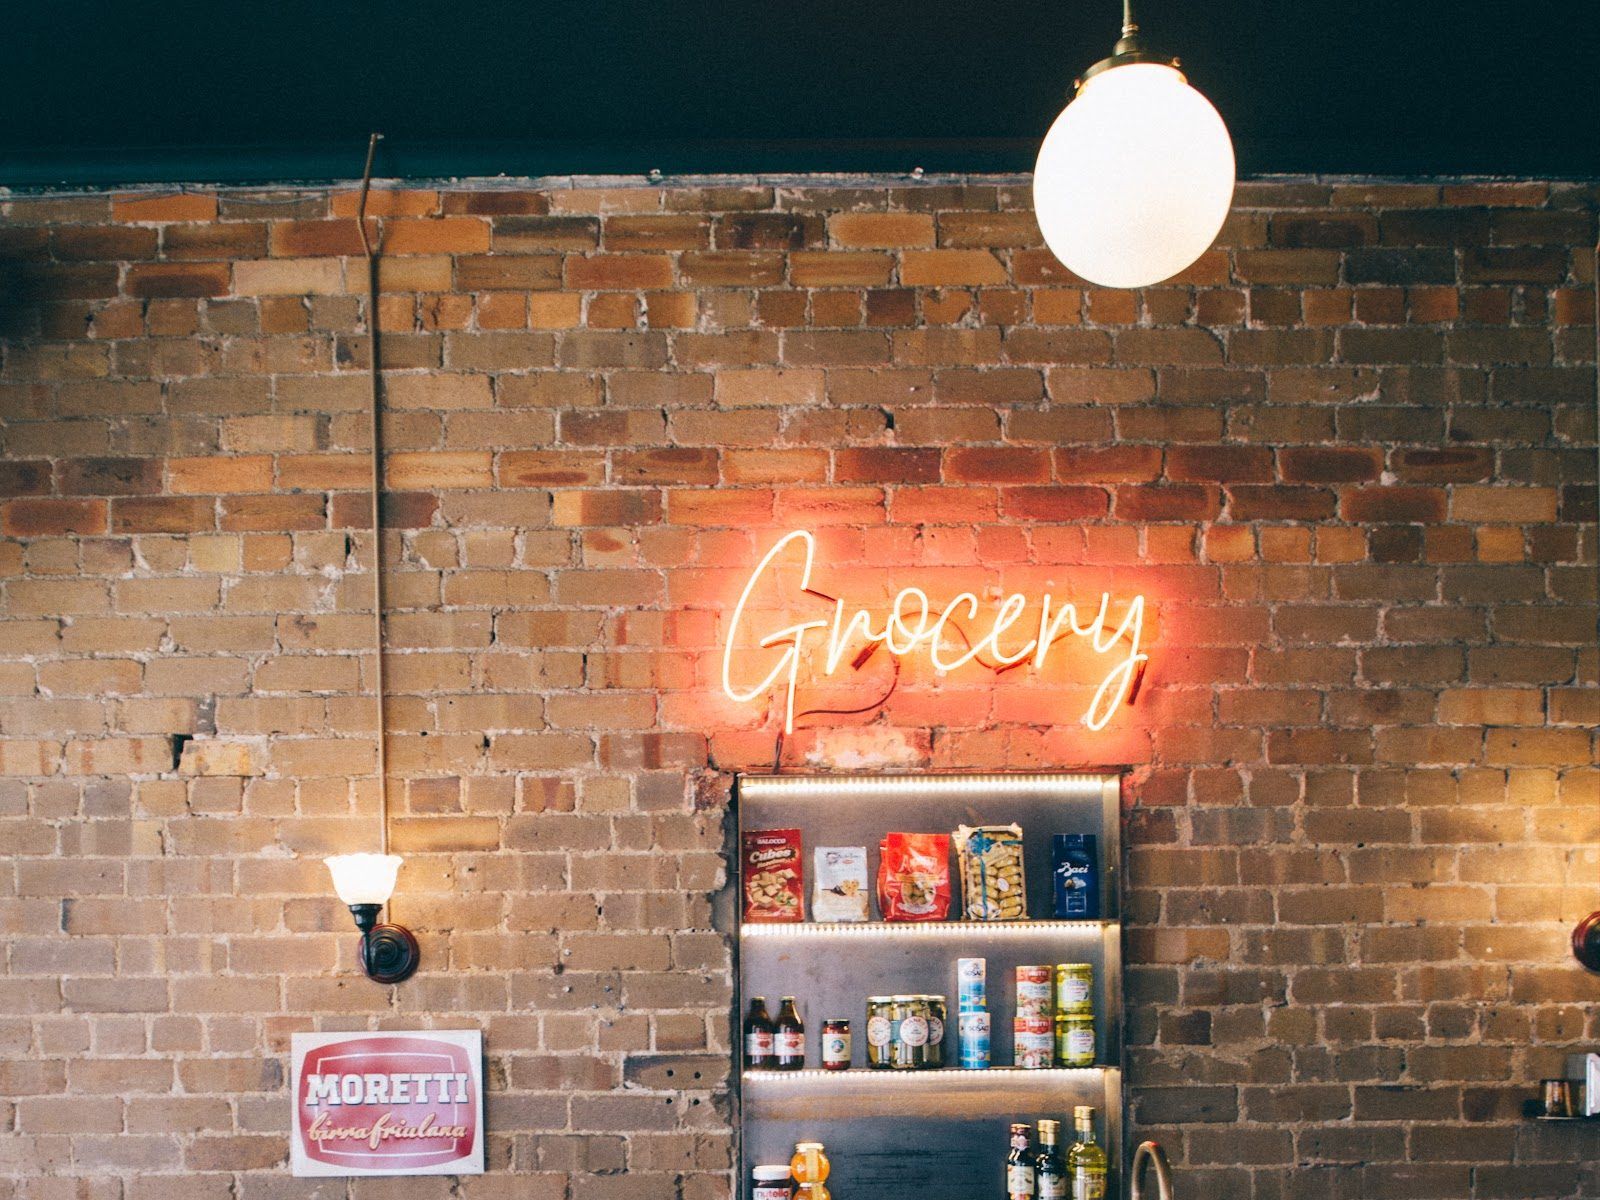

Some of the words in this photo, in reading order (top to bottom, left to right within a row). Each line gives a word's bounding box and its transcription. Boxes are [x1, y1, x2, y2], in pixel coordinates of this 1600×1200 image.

[722, 529, 1149, 735] Grocery
[749, 849, 792, 864] Cubes
[1057, 861, 1090, 877] Baci
[305, 1072, 469, 1106] MORETTI
[756, 1189, 789, 1198] nutella
